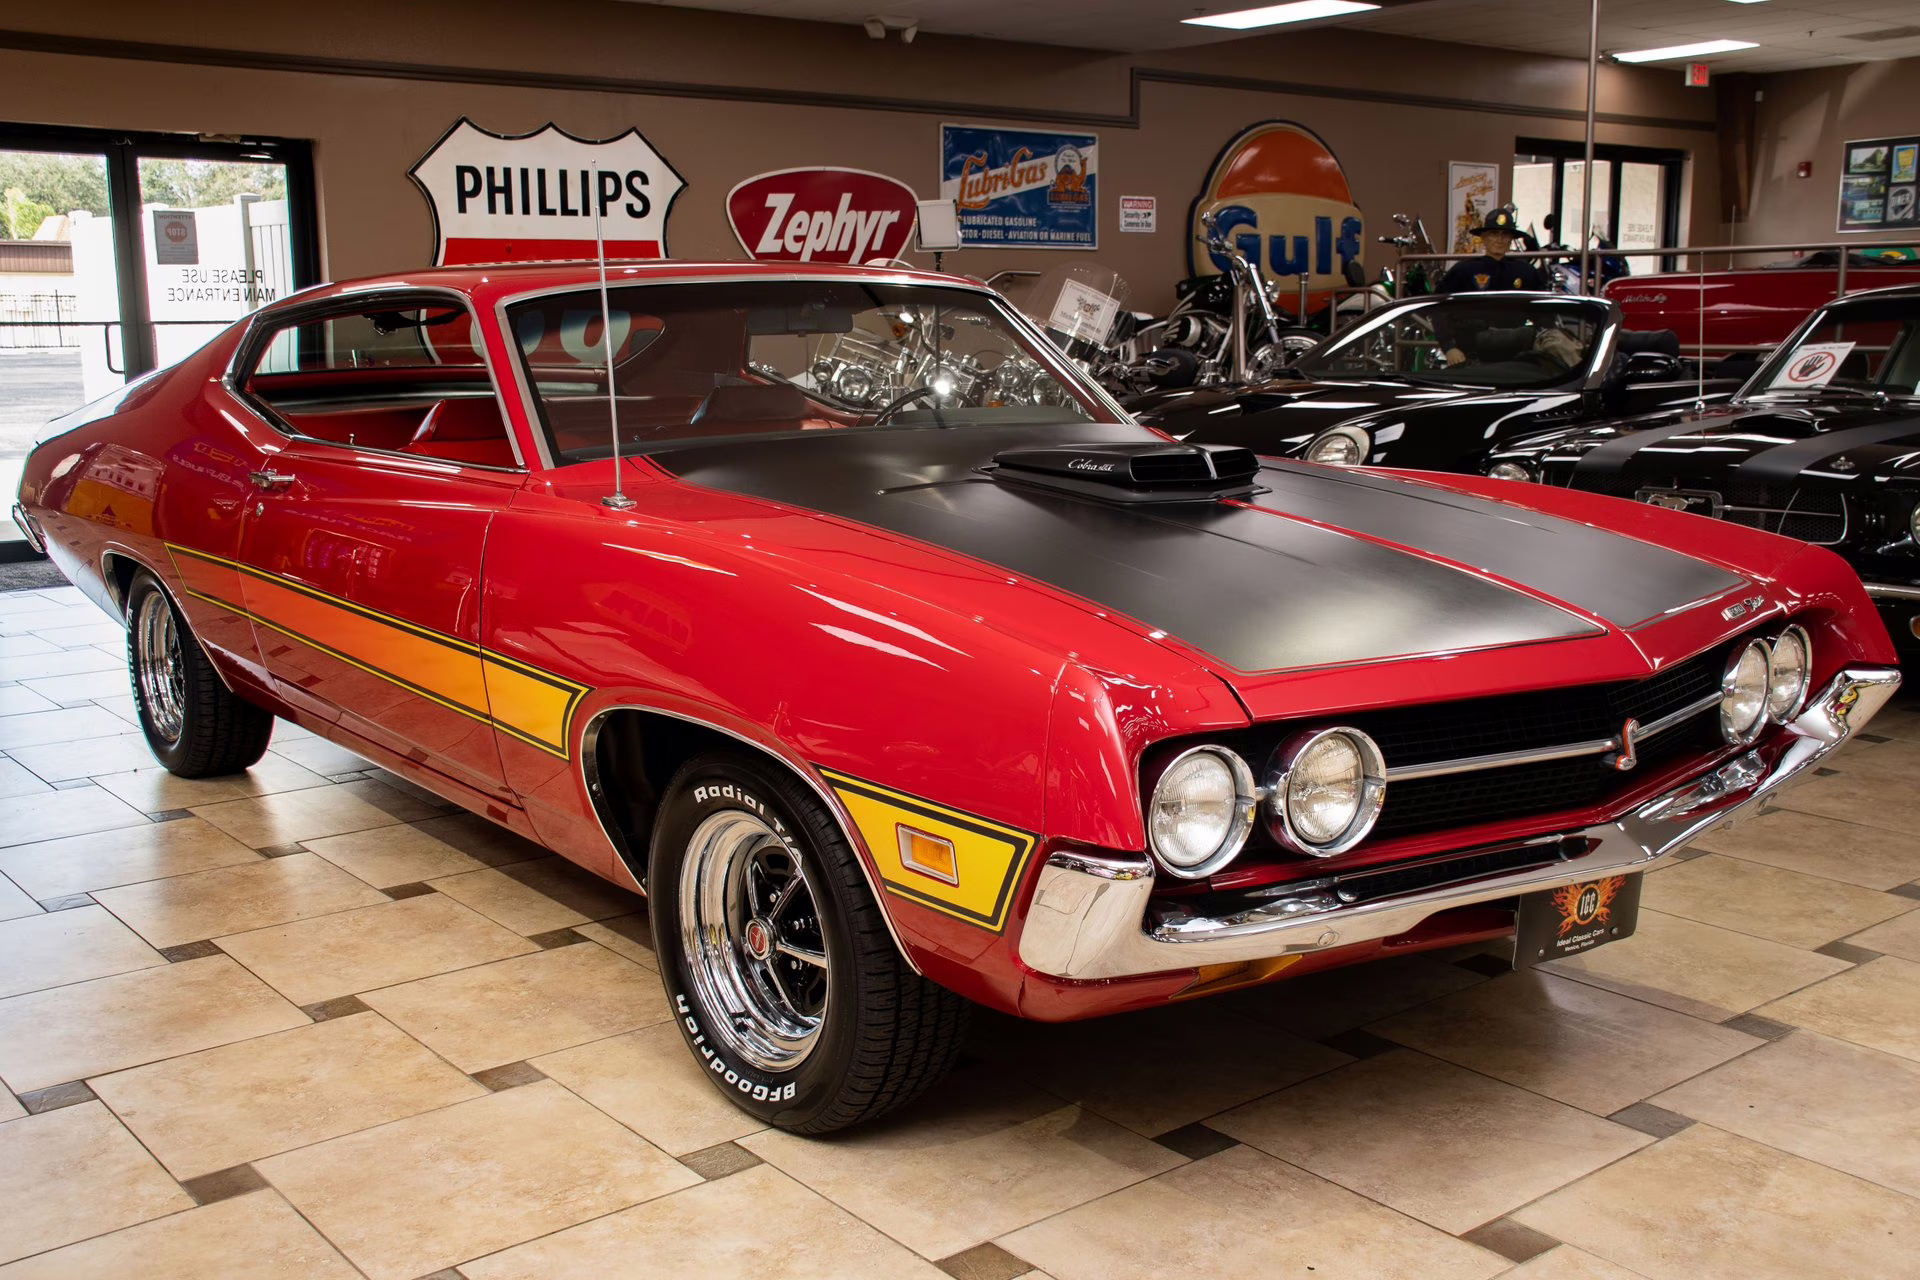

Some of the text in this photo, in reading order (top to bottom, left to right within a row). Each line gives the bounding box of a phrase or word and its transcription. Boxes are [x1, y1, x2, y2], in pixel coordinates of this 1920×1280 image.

[455, 164, 651, 219] PHILLIPS
[755, 192, 900, 265] Zephyr
[1076, 232, 1091, 241] FUEL
[1208, 205, 1362, 276] Gulf
[1068, 459, 1097, 471] Cobra
[694, 784, 765, 815] Radial
[676, 994, 796, 1102] BFGoodrich
